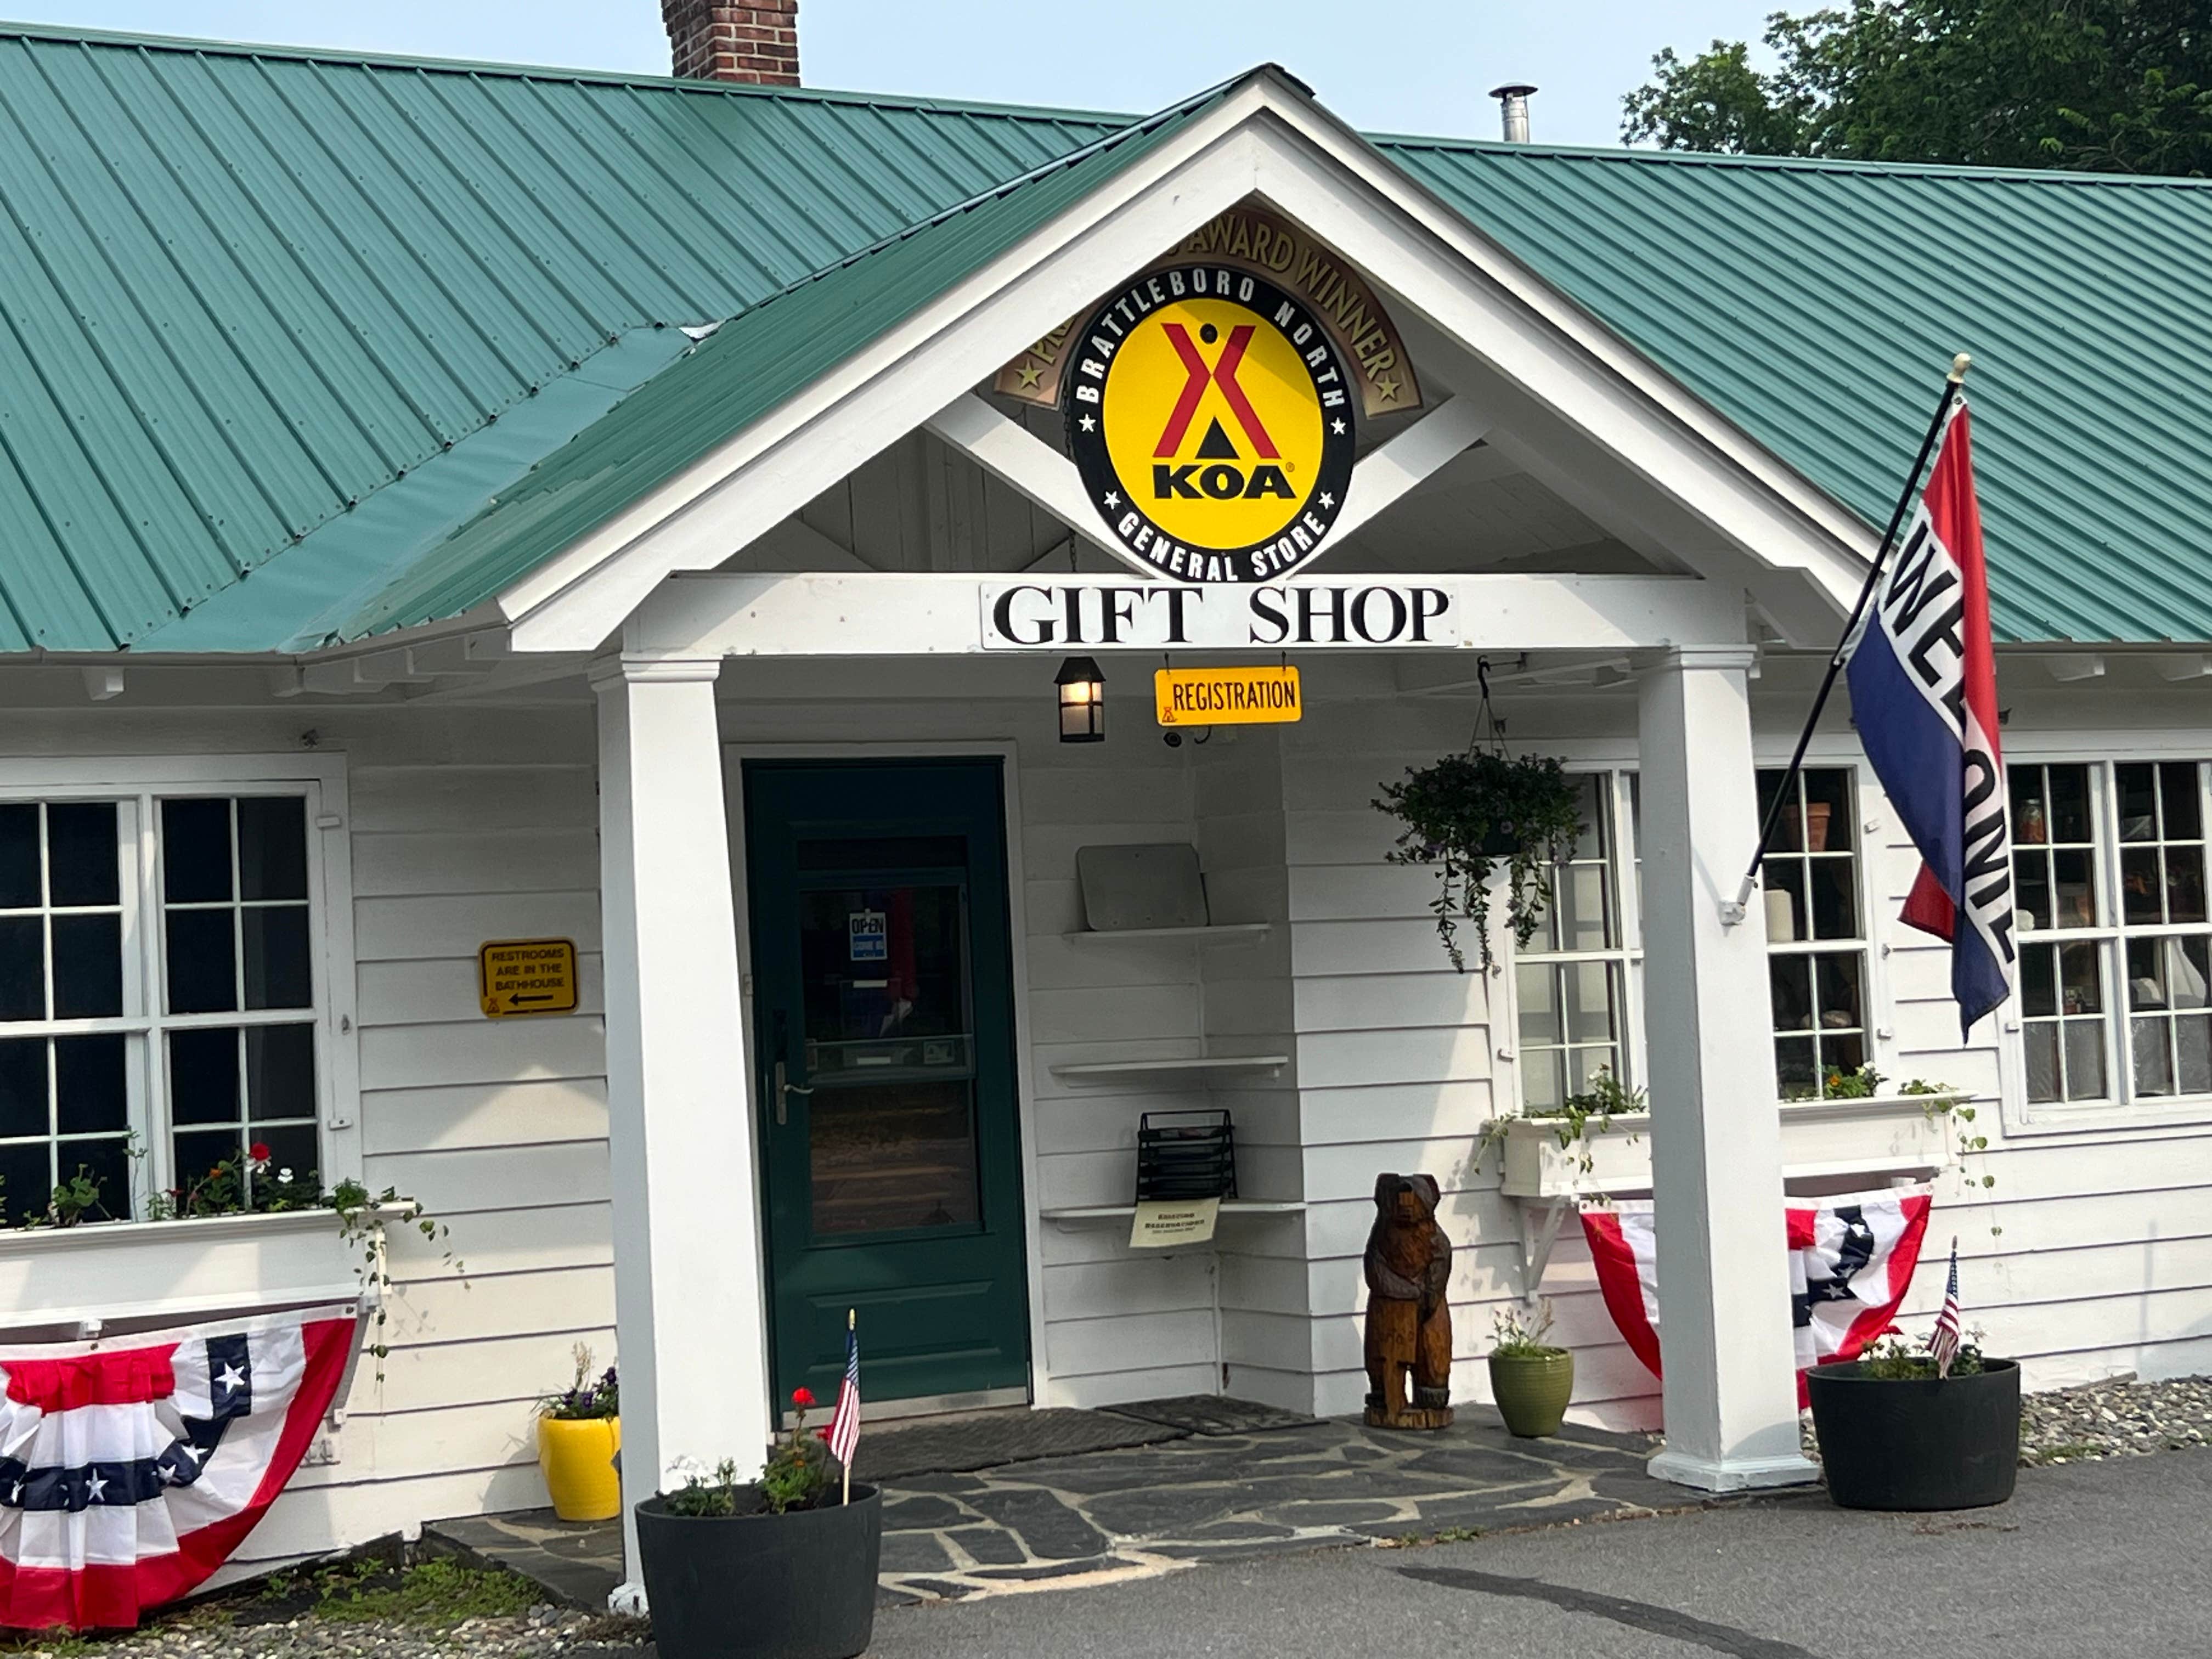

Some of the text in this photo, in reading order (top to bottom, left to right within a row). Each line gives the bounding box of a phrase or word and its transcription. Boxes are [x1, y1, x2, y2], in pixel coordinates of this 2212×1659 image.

[1187, 213, 1396, 381] AWARD WINNER
[1076, 268, 1254, 404] BRATTLEBORO
[1274, 301, 1345, 408] NORTH
[1152, 464, 1297, 500] KOA
[1118, 510, 1325, 582] GENERAL STORE
[994, 585, 1449, 645] GIFT SHOP
[1173, 680, 1295, 710] REGISTRATION
[851, 918, 884, 934] OPEN
[492, 948, 565, 962] RESTROOMS
[495, 963, 562, 977] ARE IN THE
[495, 977, 565, 991] BATHHOUSE
